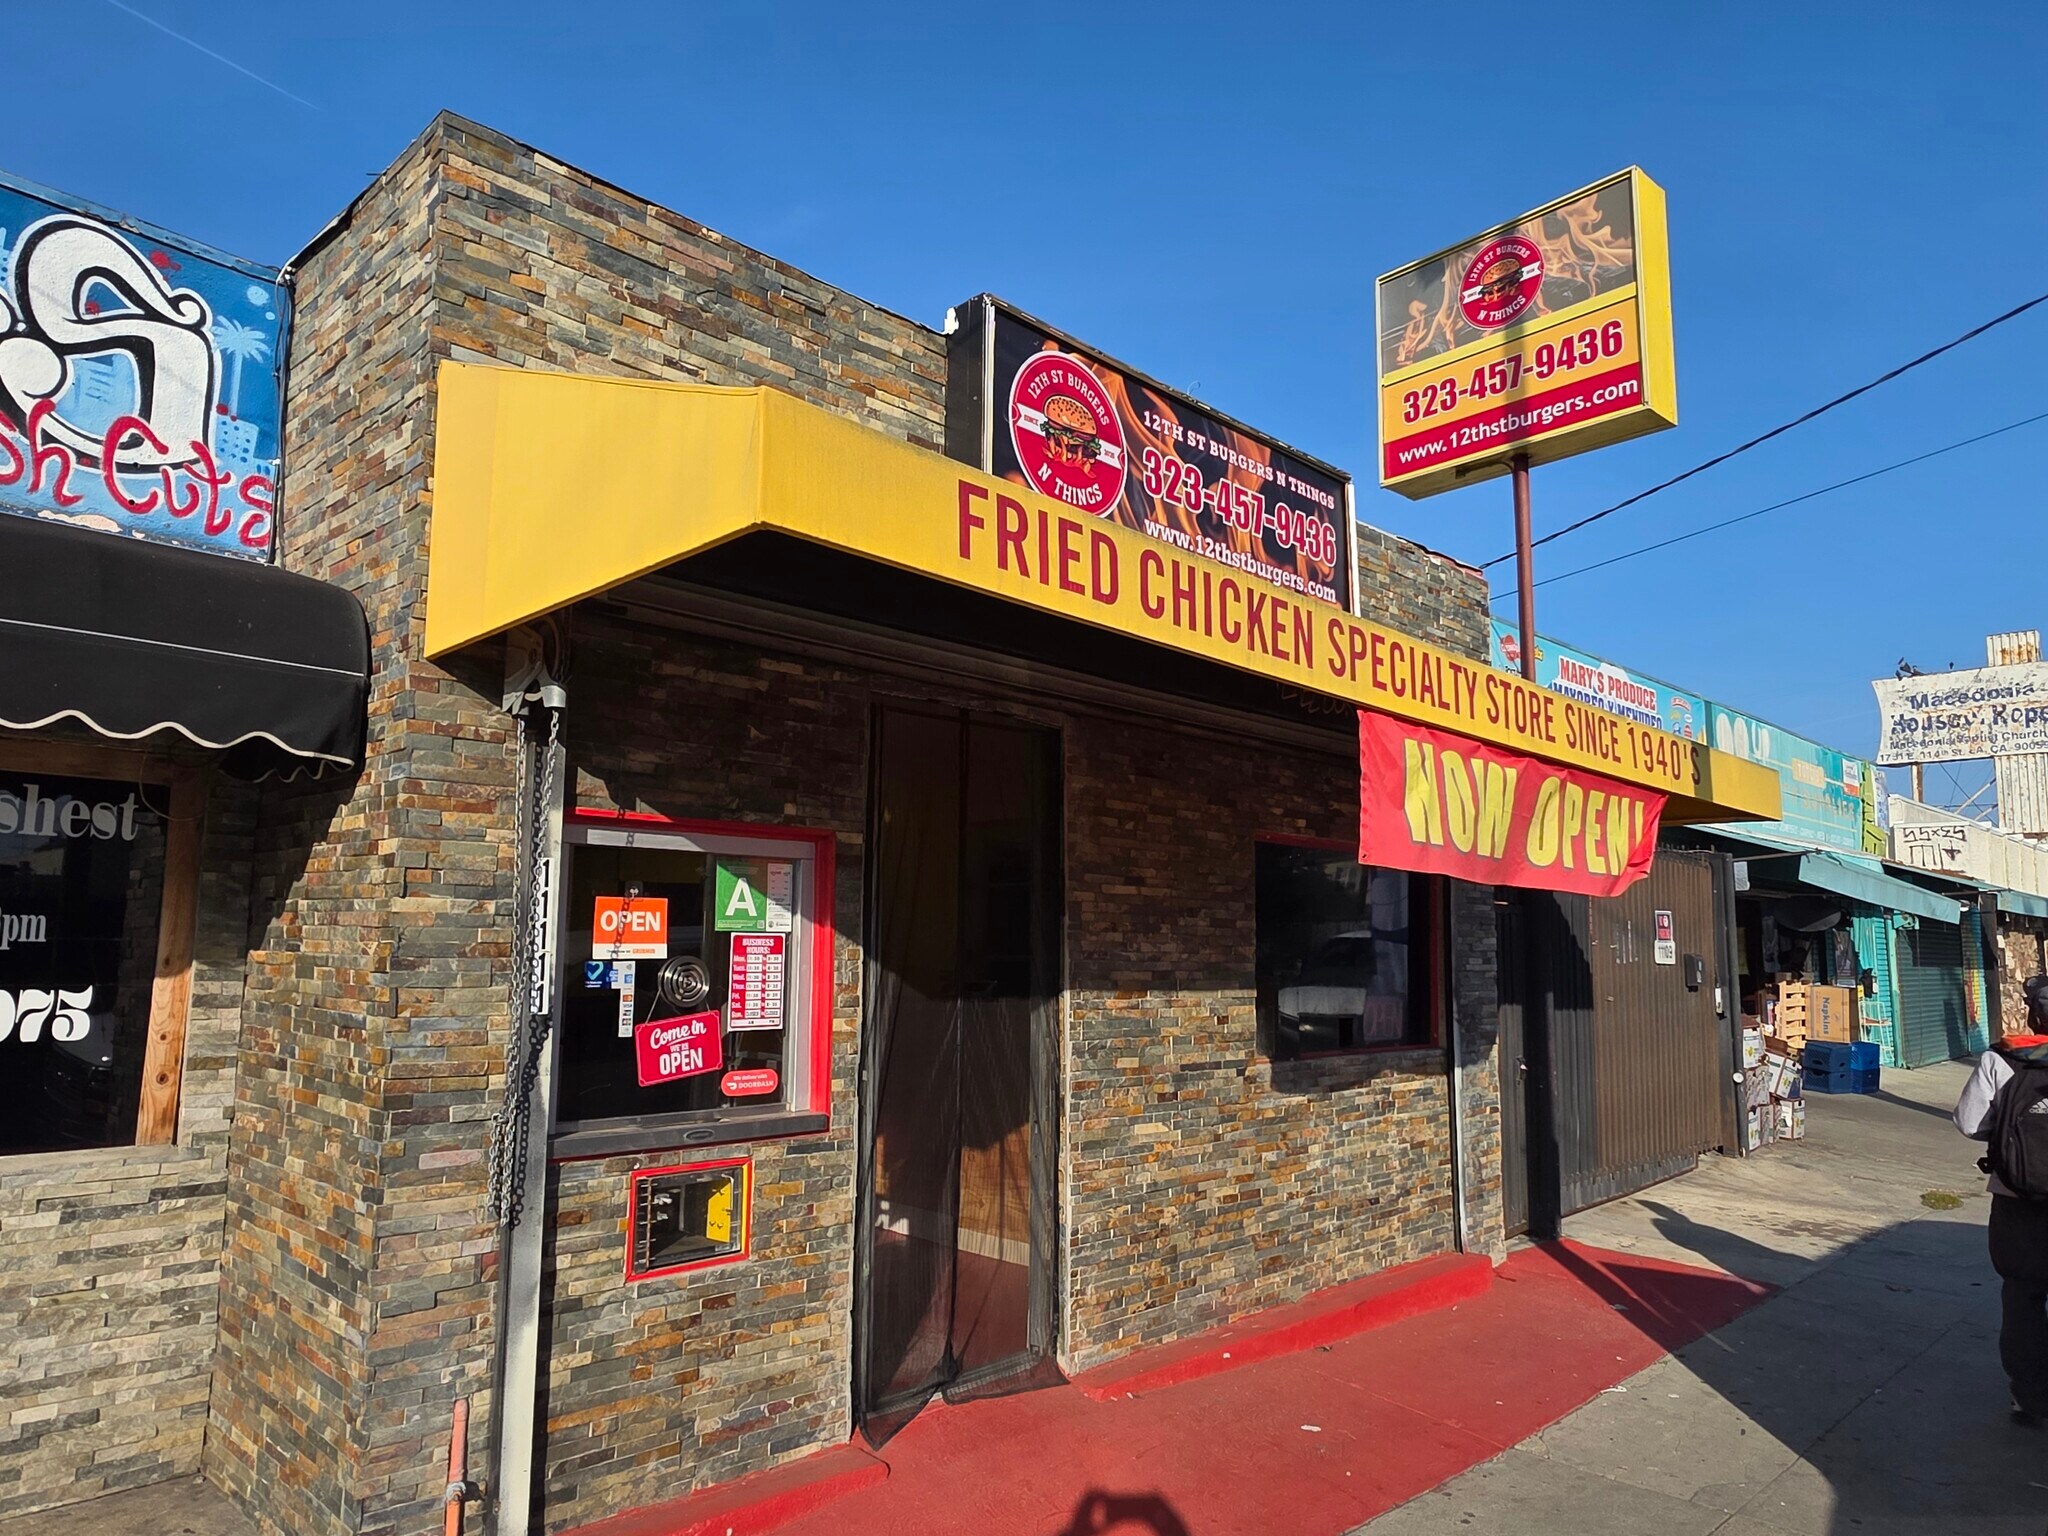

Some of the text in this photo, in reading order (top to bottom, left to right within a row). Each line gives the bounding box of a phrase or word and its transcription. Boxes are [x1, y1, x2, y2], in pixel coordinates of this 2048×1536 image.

[1468, 244, 1531, 282] 12TH ST BURGERS
[1477, 295, 1527, 322] N THINGS
[1402, 319, 1624, 425] 323-457-9436
[1027, 370, 1110, 426] 12TH ST BURGERS
[1398, 378, 1639, 463] www.12thstburgers.com
[1144, 410, 1335, 510] 12TH ST BURGERS N THINGS
[1037, 462, 1103, 506] N THINGS
[1142, 446, 1337, 568] 323-457-9436
[1143, 517, 1337, 604] www.12thstburgers.com
[958, 479, 1119, 605] FRIED
[1140, 548, 1313, 670] CHICKEN
[1328, 617, 1478, 720] SPECIALTY
[1486, 674, 1557, 744] STORE
[1565, 704, 1622, 764] SINCE
[1628, 724, 1701, 785] 1940'S
[1560, 658, 1605, 693] MARY'S
[1608, 675, 1656, 713] PRODUCE
[1906, 683, 2035, 710] Macedonia
[2001, 728, 2048, 743] Church
[1404, 738, 1644, 876] NOW OPEN!
[725, 877, 758, 917] A
[600, 910, 660, 932] OPEN
[742, 938, 774, 947] BUSINESS
[746, 946, 771, 955] HOURS:
[650, 1020, 707, 1049] Come in
[1821, 996, 1831, 1035] Napkins
[660, 1047, 703, 1075] OPEN
[738, 1080, 774, 1089] DOORDASH
